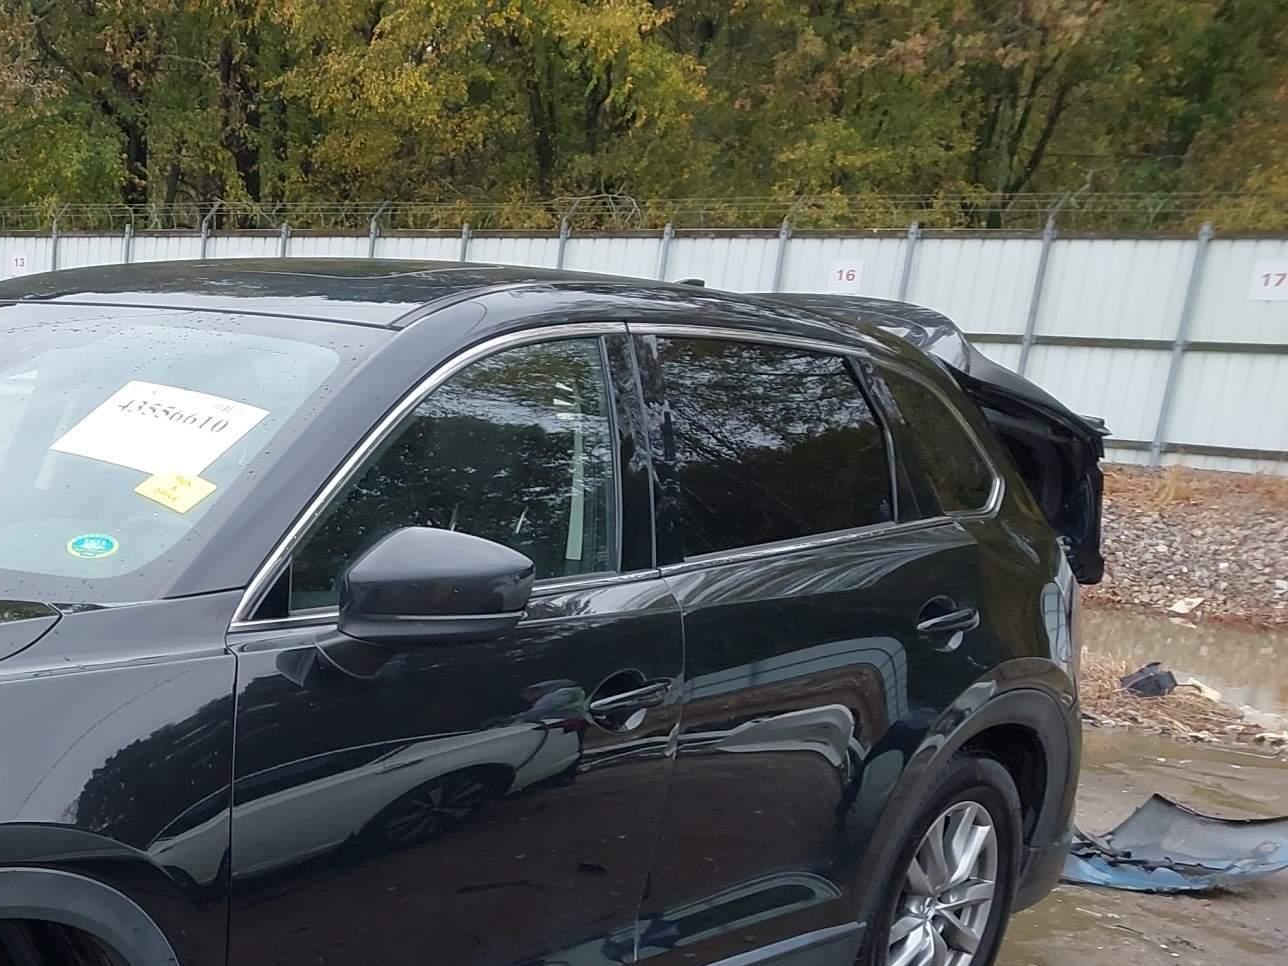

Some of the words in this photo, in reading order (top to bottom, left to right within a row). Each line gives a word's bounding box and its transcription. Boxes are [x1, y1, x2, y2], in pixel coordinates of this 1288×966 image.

[14, 257, 26, 268] 13
[836, 268, 857, 282] 16
[1261, 272, 1288, 287] 17
[117, 399, 230, 433] 43556610
